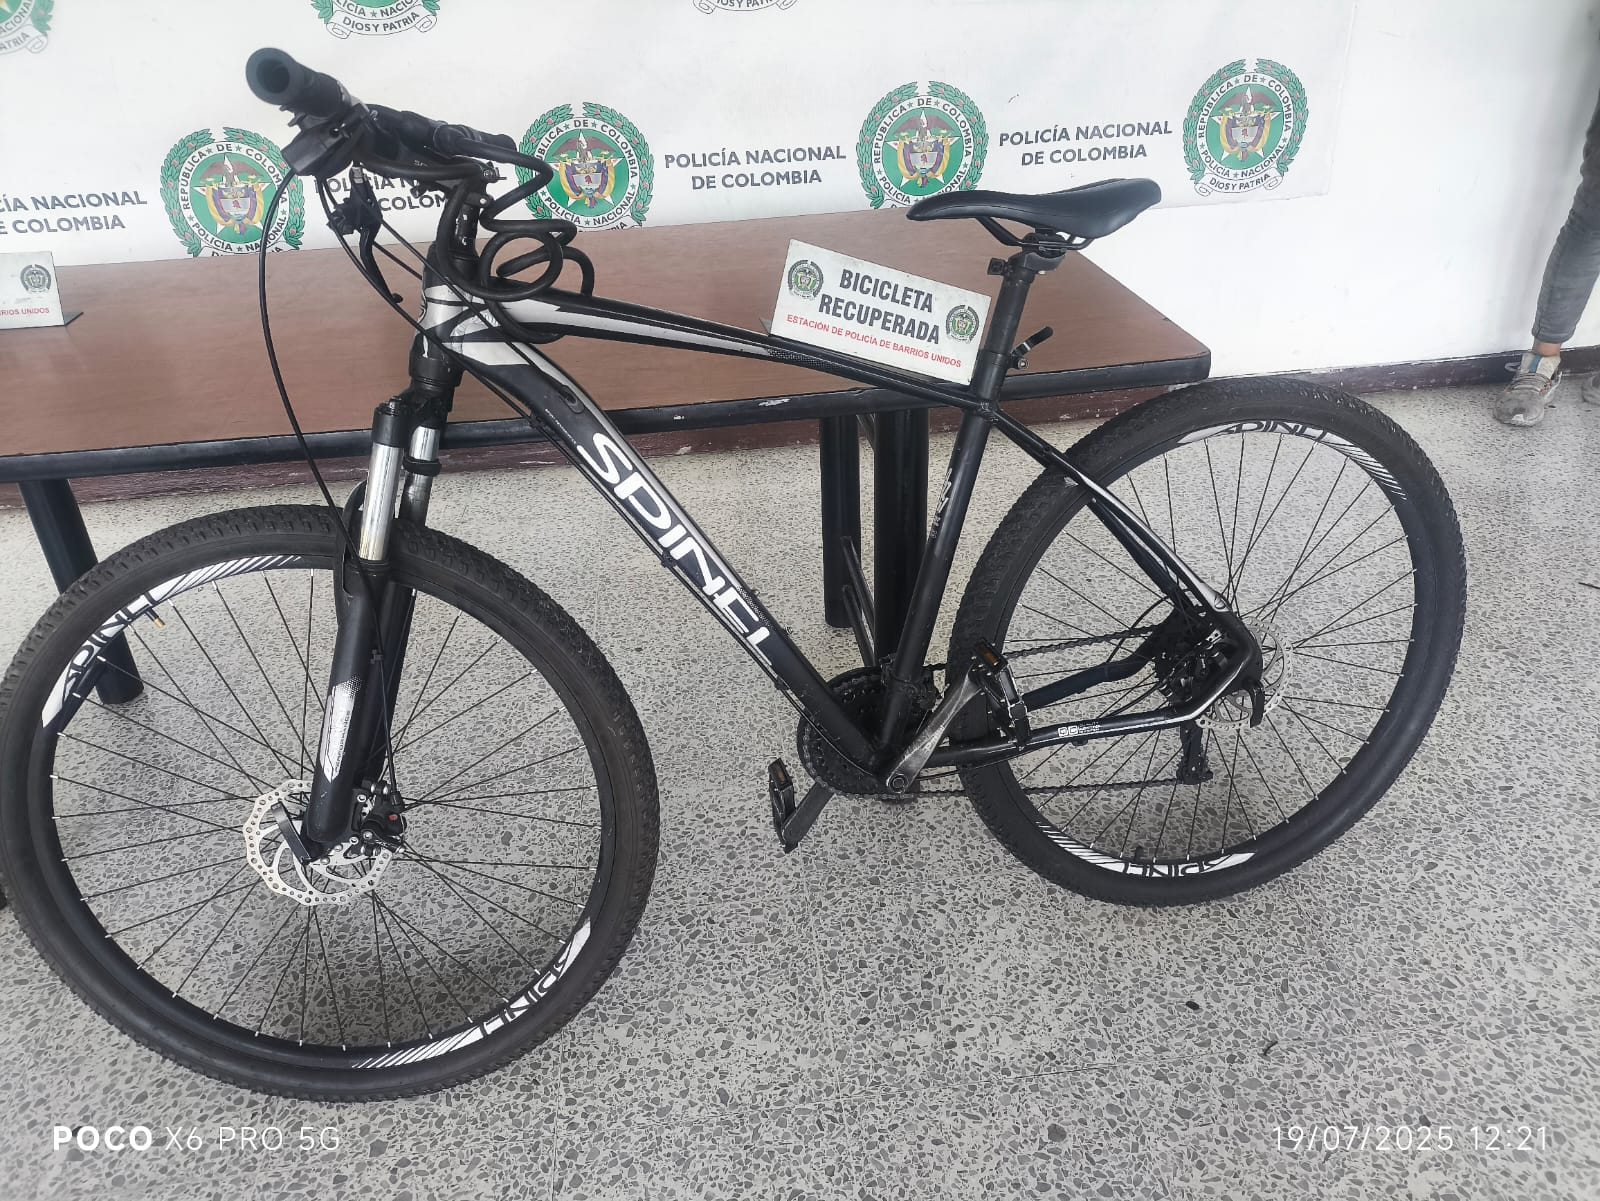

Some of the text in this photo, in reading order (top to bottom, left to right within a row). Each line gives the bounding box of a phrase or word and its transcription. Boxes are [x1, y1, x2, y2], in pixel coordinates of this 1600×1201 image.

[382, 11, 420, 32] PATRIA
[1243, 74, 1258, 83] DE
[1268, 79, 1292, 132] COLOMBIA
[917, 97, 932, 107] DE
[942, 103, 972, 158] COLOMBIA
[999, 120, 1172, 146] POLICÍA NACIONAL
[216, 143, 233, 152] DE
[573, 119, 589, 128] DE
[600, 124, 638, 179] COLOMBIA
[664, 146, 846, 168] POLICÍA NACIONAL
[1021, 144, 1147, 166] DE COLOMBIA
[1240, 144, 1286, 178] NACIONAL
[691, 169, 822, 190] DE COLOMBIA
[1239, 173, 1271, 190] PATRIA
[31, 191, 147, 210] NACIONAL
[592, 191, 636, 226] NACIONAL
[12, 215, 125, 233] COLOMBIA
[840, 269, 933, 313] BICICLETA
[21, 307, 50, 315] UNIDOS
[819, 293, 939, 344] RECUPERADA
[787, 314, 829, 332] ESTACIÓN
[831, 326, 843, 336] DE
[879, 339, 892, 349] DE
[892, 342, 929, 359] BARRIOS
[931, 352, 962, 368] UNIDOS
